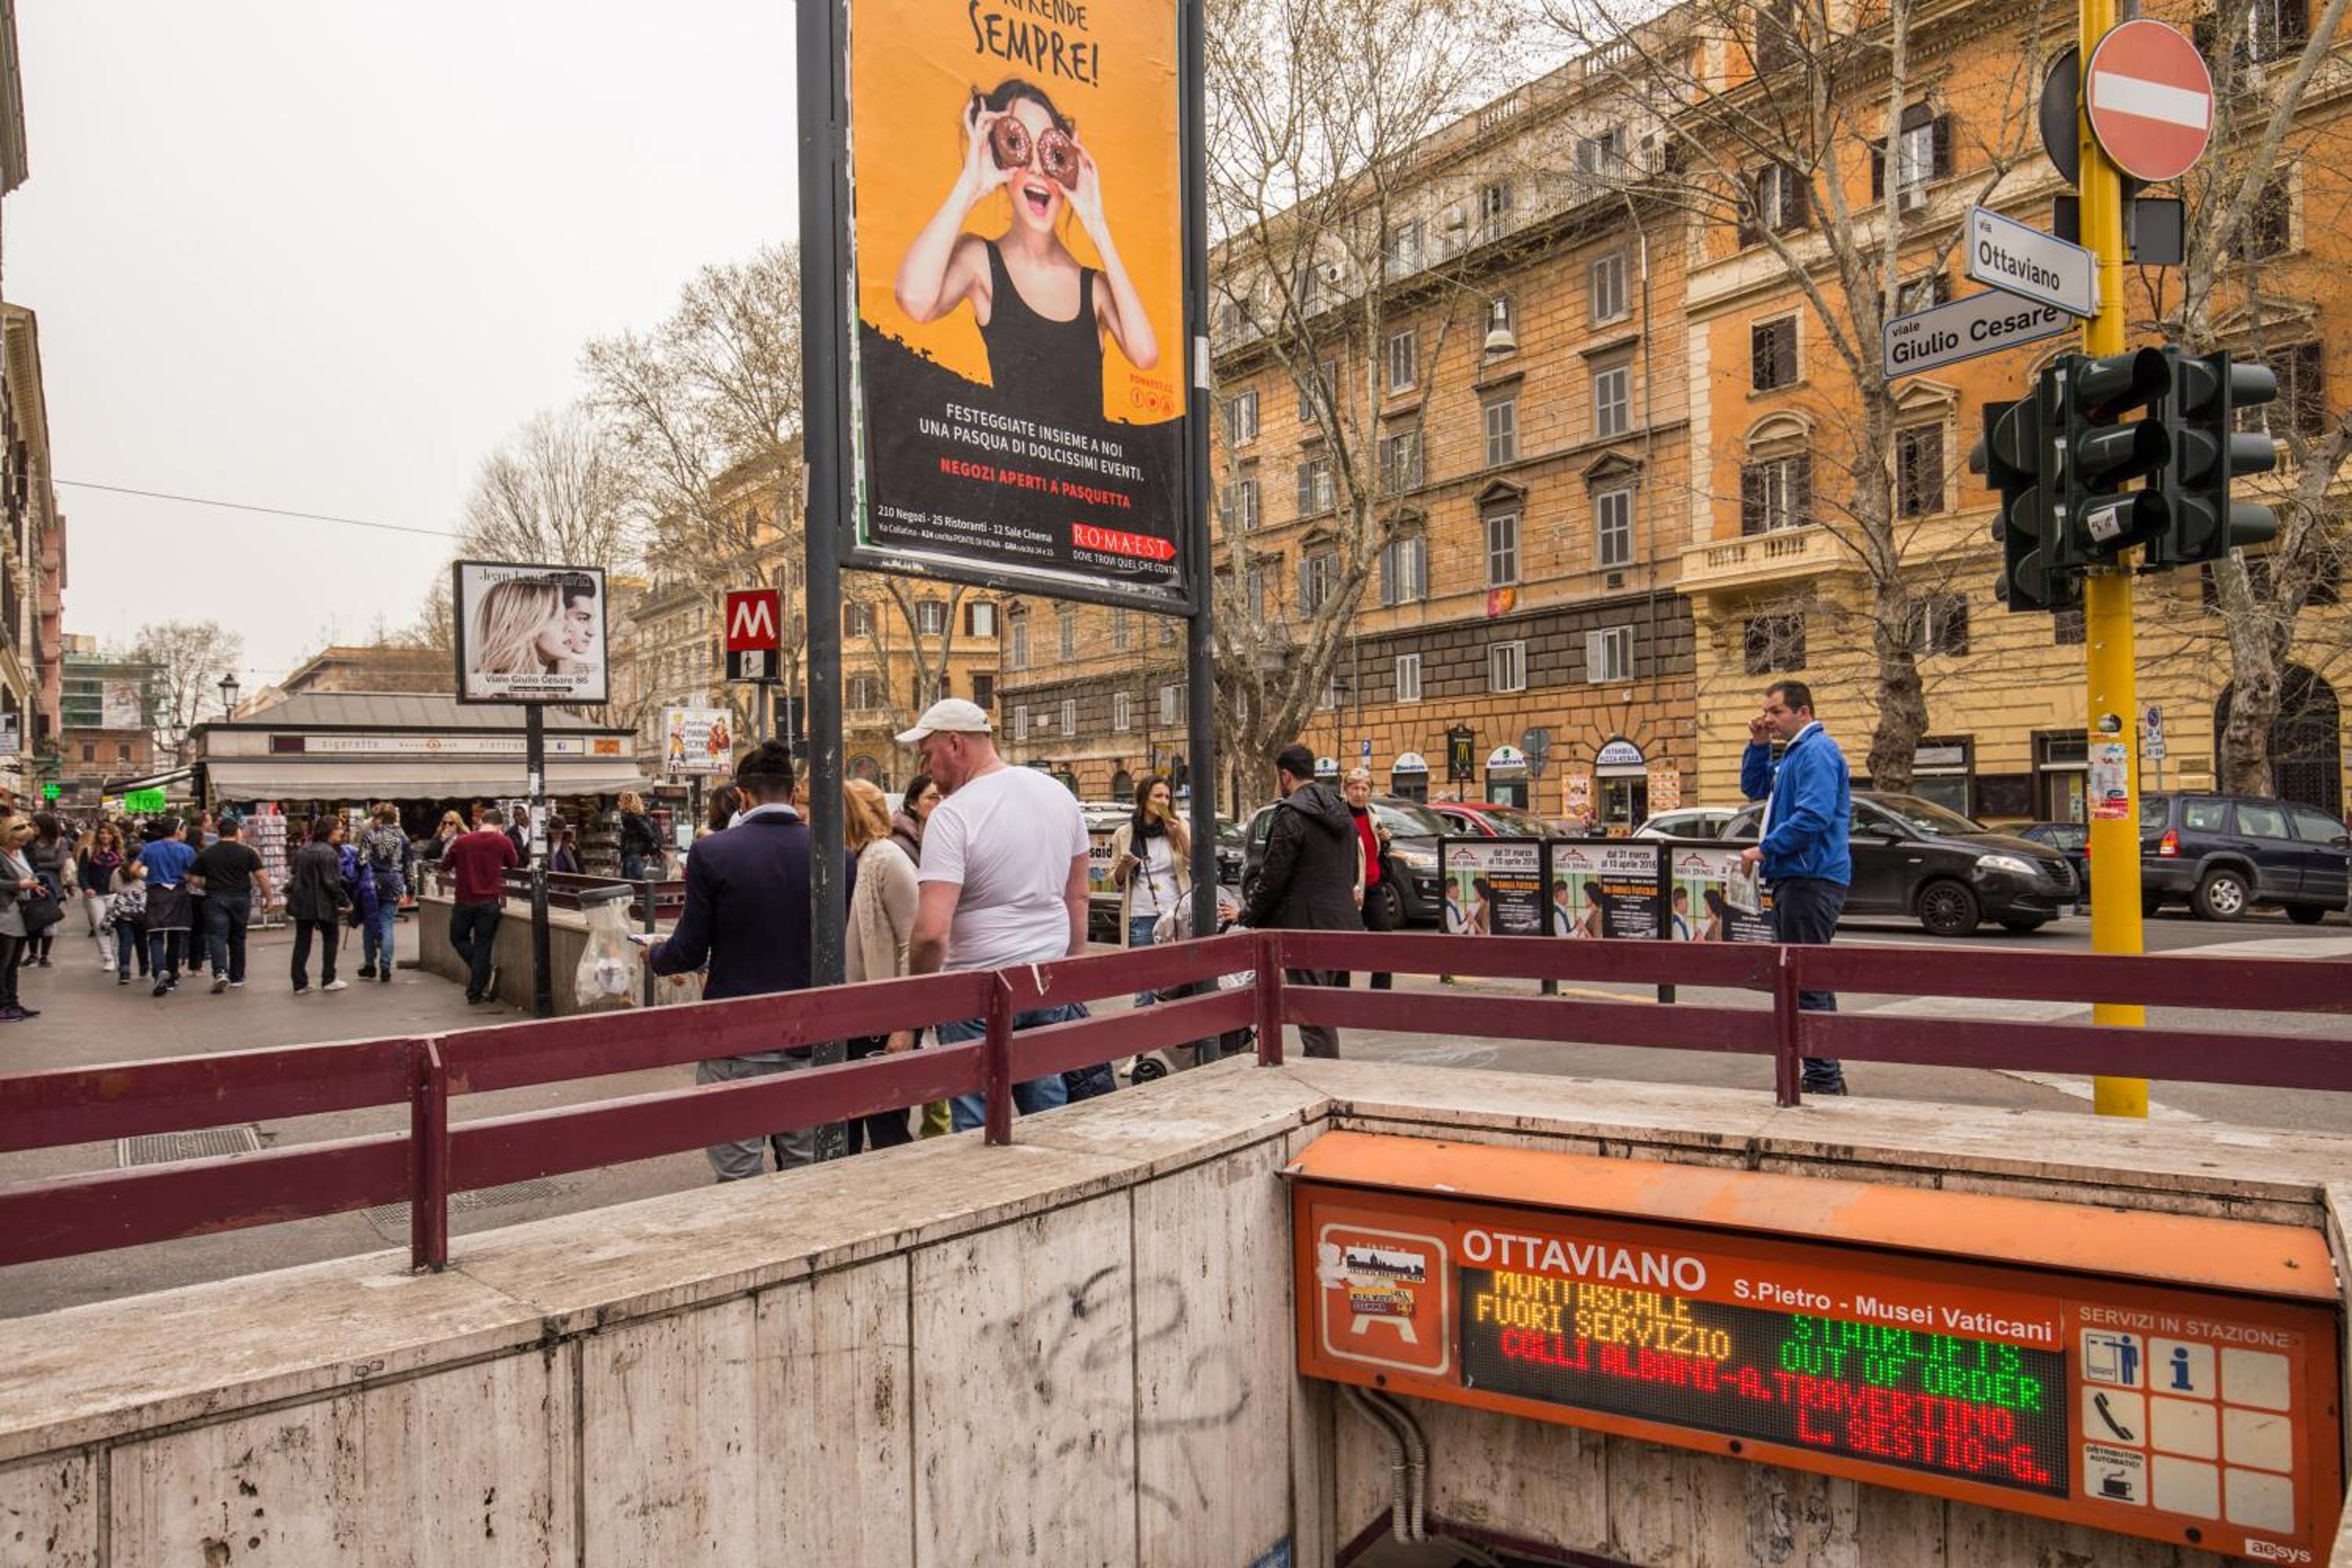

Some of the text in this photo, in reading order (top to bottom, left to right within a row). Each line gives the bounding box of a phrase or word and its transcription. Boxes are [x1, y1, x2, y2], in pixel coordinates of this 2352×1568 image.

[969, 0, 1098, 88] SEMPRE!
[1978, 220, 1992, 233] via
[1980, 240, 2060, 291] Ottaviano
[1893, 321, 1920, 337] viale
[1893, 305, 2057, 363] Giulio Cesare
[920, 417, 1145, 482] UNA PASQUA DI DOLCISSIMI EVENTI.
[946, 403, 1122, 458] FESTEGGIATE INSIEME A NOI
[939, 457, 1131, 509] NEGOZI APERTI A PASQUETTA
[878, 506, 894, 518] 210
[896, 509, 926, 524] Negozi
[933, 514, 943, 526] 25
[945, 517, 987, 533] Ristoranti
[993, 524, 1003, 535] 12
[1005, 526, 1022, 539] Sale
[1023, 528, 1054, 543] Cinema
[1073, 550, 1092, 562] DOVE
[1117, 557, 1137, 569] QUEL
[1138, 561, 1153, 572] CHE
[730, 600, 776, 640] M
[511, 675, 539, 684] Giulio
[541, 675, 573, 684] Cesare
[1090, 841, 1112, 858] said
[1463, 1229, 1708, 1292] OTTAVIANO
[1494, 1270, 1693, 1325] MONTASCALE
[1733, 1279, 1831, 1311] S.Pietro
[1856, 1295, 1933, 1325] Musei
[1942, 1308, 2053, 1342] Vaticani
[1476, 1293, 1731, 1361] FUORI SERVIZIO
[2079, 1306, 2292, 1348] SERVIZI IN STAZIONE
[1780, 1339, 2043, 1413] OUT OF ORDER
[2252, 1541, 2312, 1563] aesys
